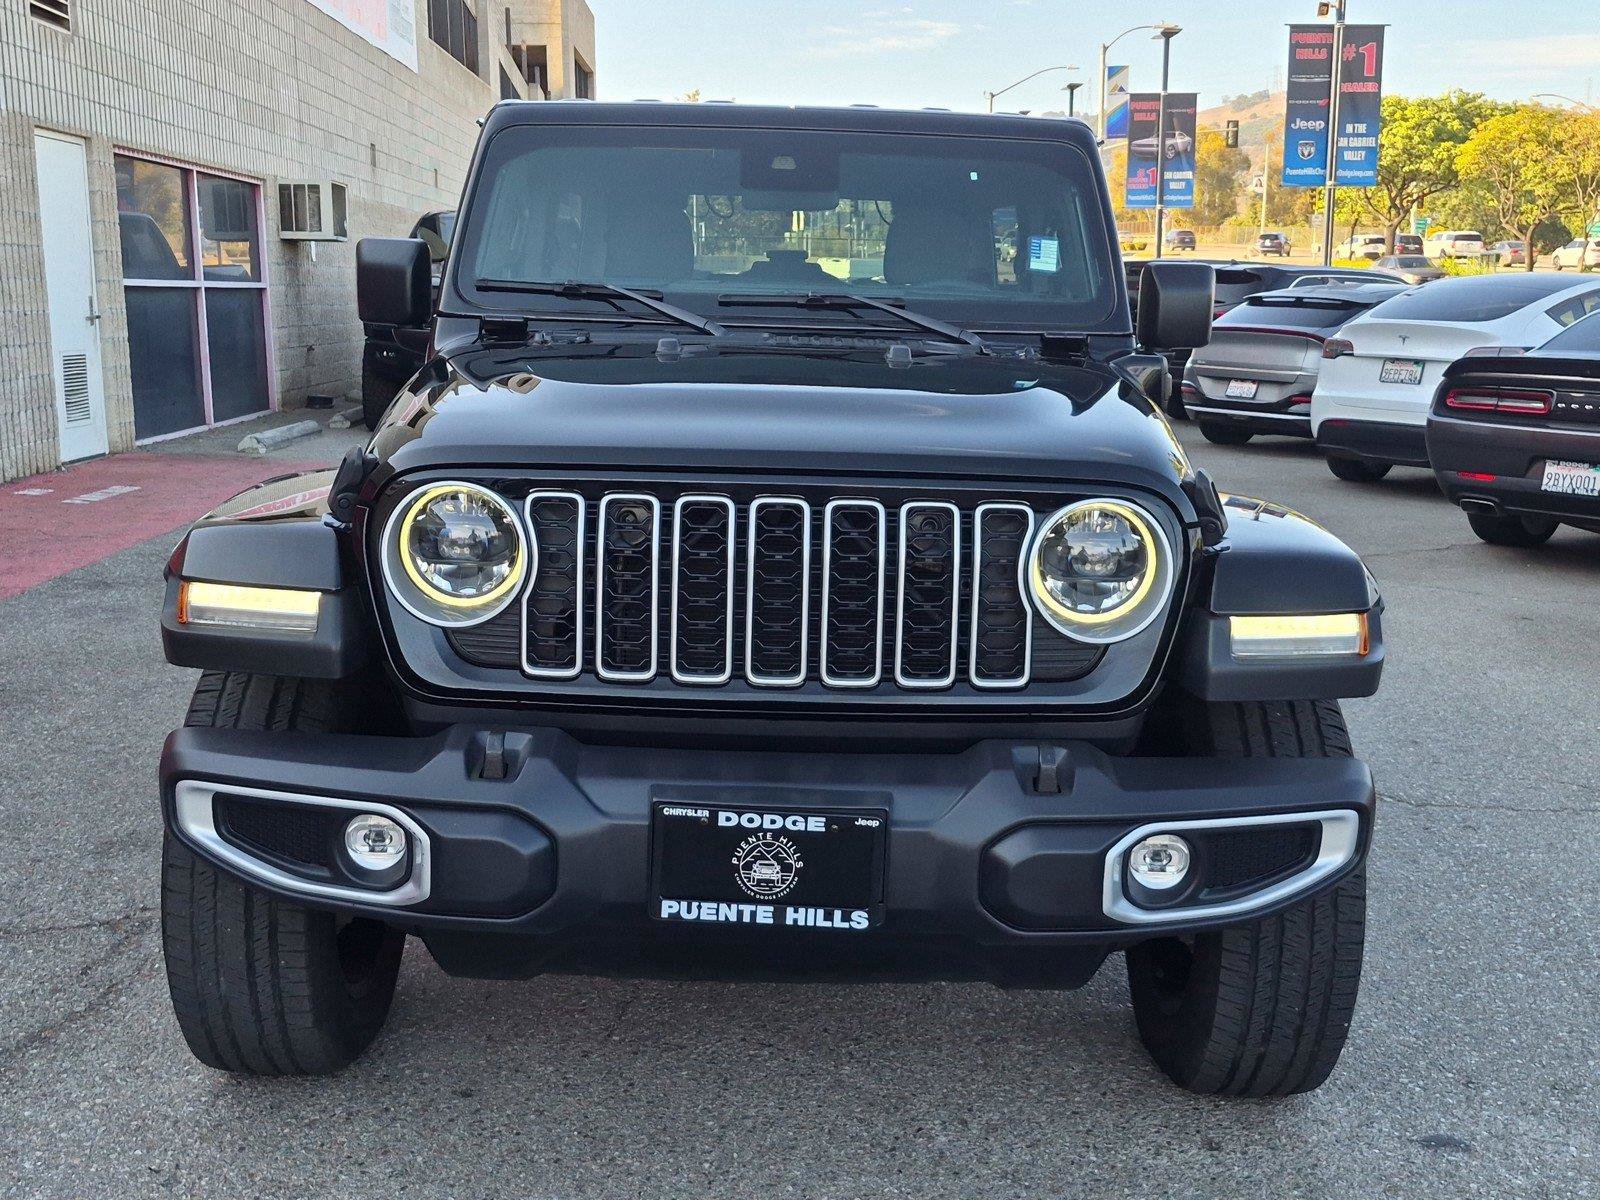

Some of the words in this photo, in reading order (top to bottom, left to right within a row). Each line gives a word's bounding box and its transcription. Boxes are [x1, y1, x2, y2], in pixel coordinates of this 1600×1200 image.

[1291, 32, 1333, 44] PUENTE
[1296, 48, 1328, 60] HILLS
[1342, 42, 1376, 76] #1
[1290, 117, 1326, 132] Jeep
[1345, 123, 1354, 134] IN
[1354, 123, 1368, 134] THE
[1349, 136, 1376, 147] GABRIEL
[1343, 150, 1366, 161] VALLEY
[1545, 472, 1597, 490] 9BYX001
[663, 807, 710, 818] CHRYSLER
[718, 811, 826, 832] DODGE
[854, 817, 880, 828] Jeep
[731, 832, 773, 865] PUENTE
[778, 834, 804, 869] HILLS
[661, 899, 774, 925] PUENTE
[786, 907, 869, 930] HILLS
